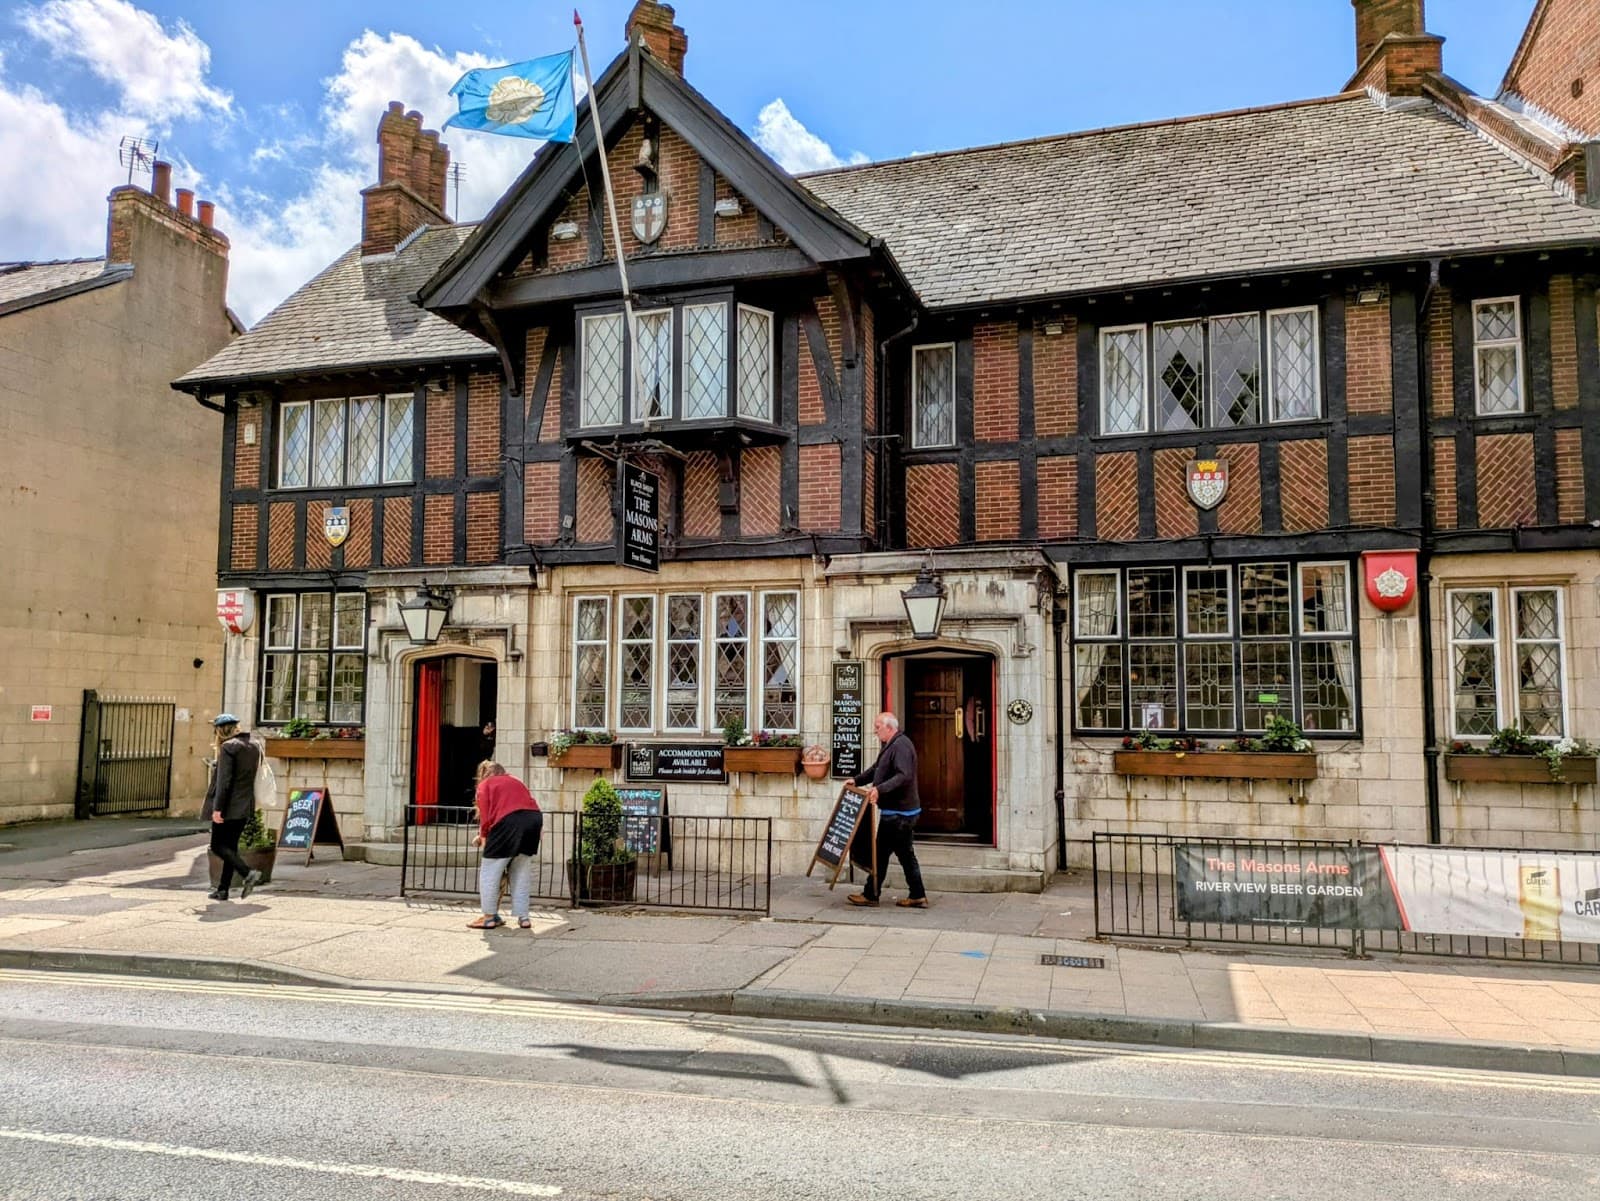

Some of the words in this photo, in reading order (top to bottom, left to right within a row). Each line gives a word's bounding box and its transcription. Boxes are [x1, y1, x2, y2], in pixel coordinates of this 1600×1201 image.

[634, 496, 650, 513] THE
[625, 509, 658, 532] MASONS
[631, 528, 653, 546] ARMS
[834, 717, 860, 725] FOOD
[834, 733, 860, 741] DAILY
[657, 749, 721, 757] ACCOMMODATION
[672, 758, 707, 766] AVAILABLE
[697, 767, 705, 776] for
[705, 767, 721, 775] details
[292, 799, 312, 811] BEER
[287, 816, 312, 829] GARDEN
[1207, 857, 1236, 872] The
[1241, 859, 1301, 873] Masons
[1305, 861, 1350, 876] Arms
[1195, 880, 1231, 893] RIVER
[1233, 882, 1267, 894] VIEW
[1270, 883, 1303, 896] BEER
[1306, 884, 1364, 897] GARDEN
